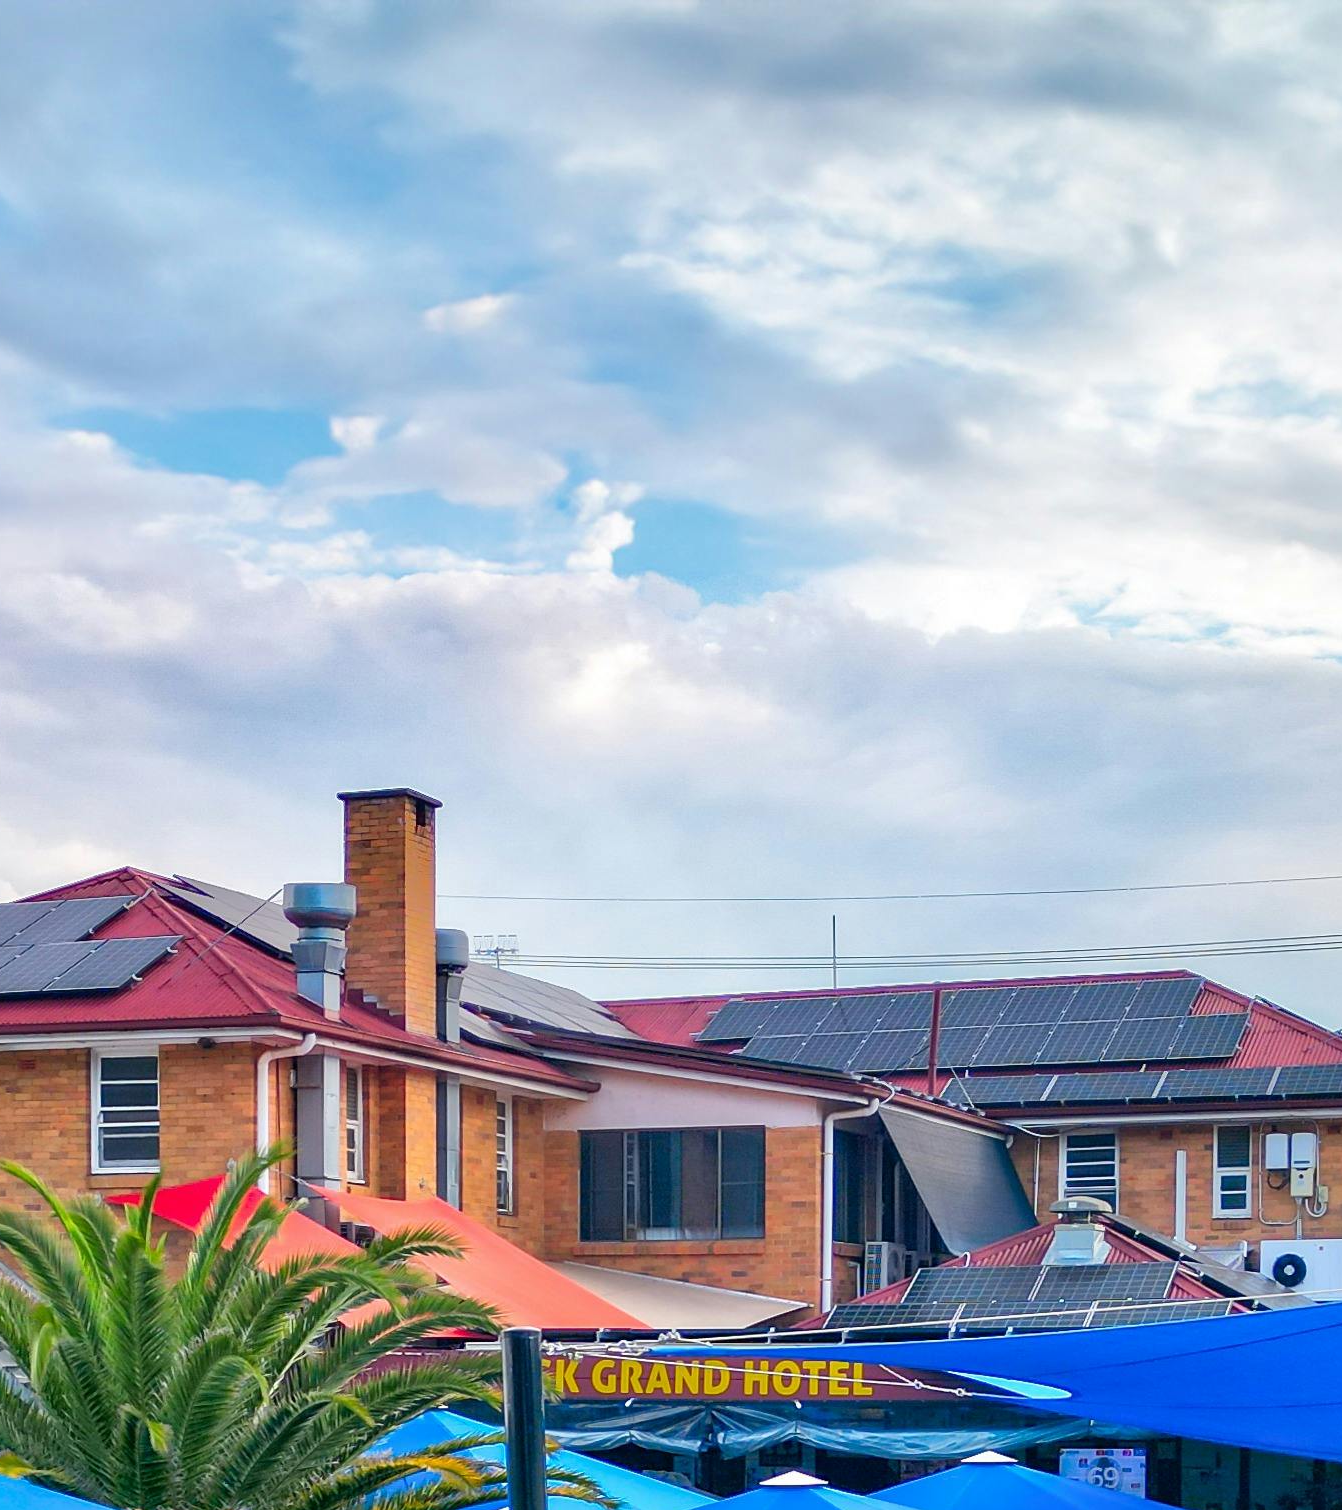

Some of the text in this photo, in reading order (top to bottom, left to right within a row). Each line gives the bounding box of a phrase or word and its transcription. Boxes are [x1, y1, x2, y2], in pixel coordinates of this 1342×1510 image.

[591, 1359, 731, 1395] GRAND
[743, 1360, 873, 1396] HOTEL
[1088, 1466, 1120, 1489] 69
